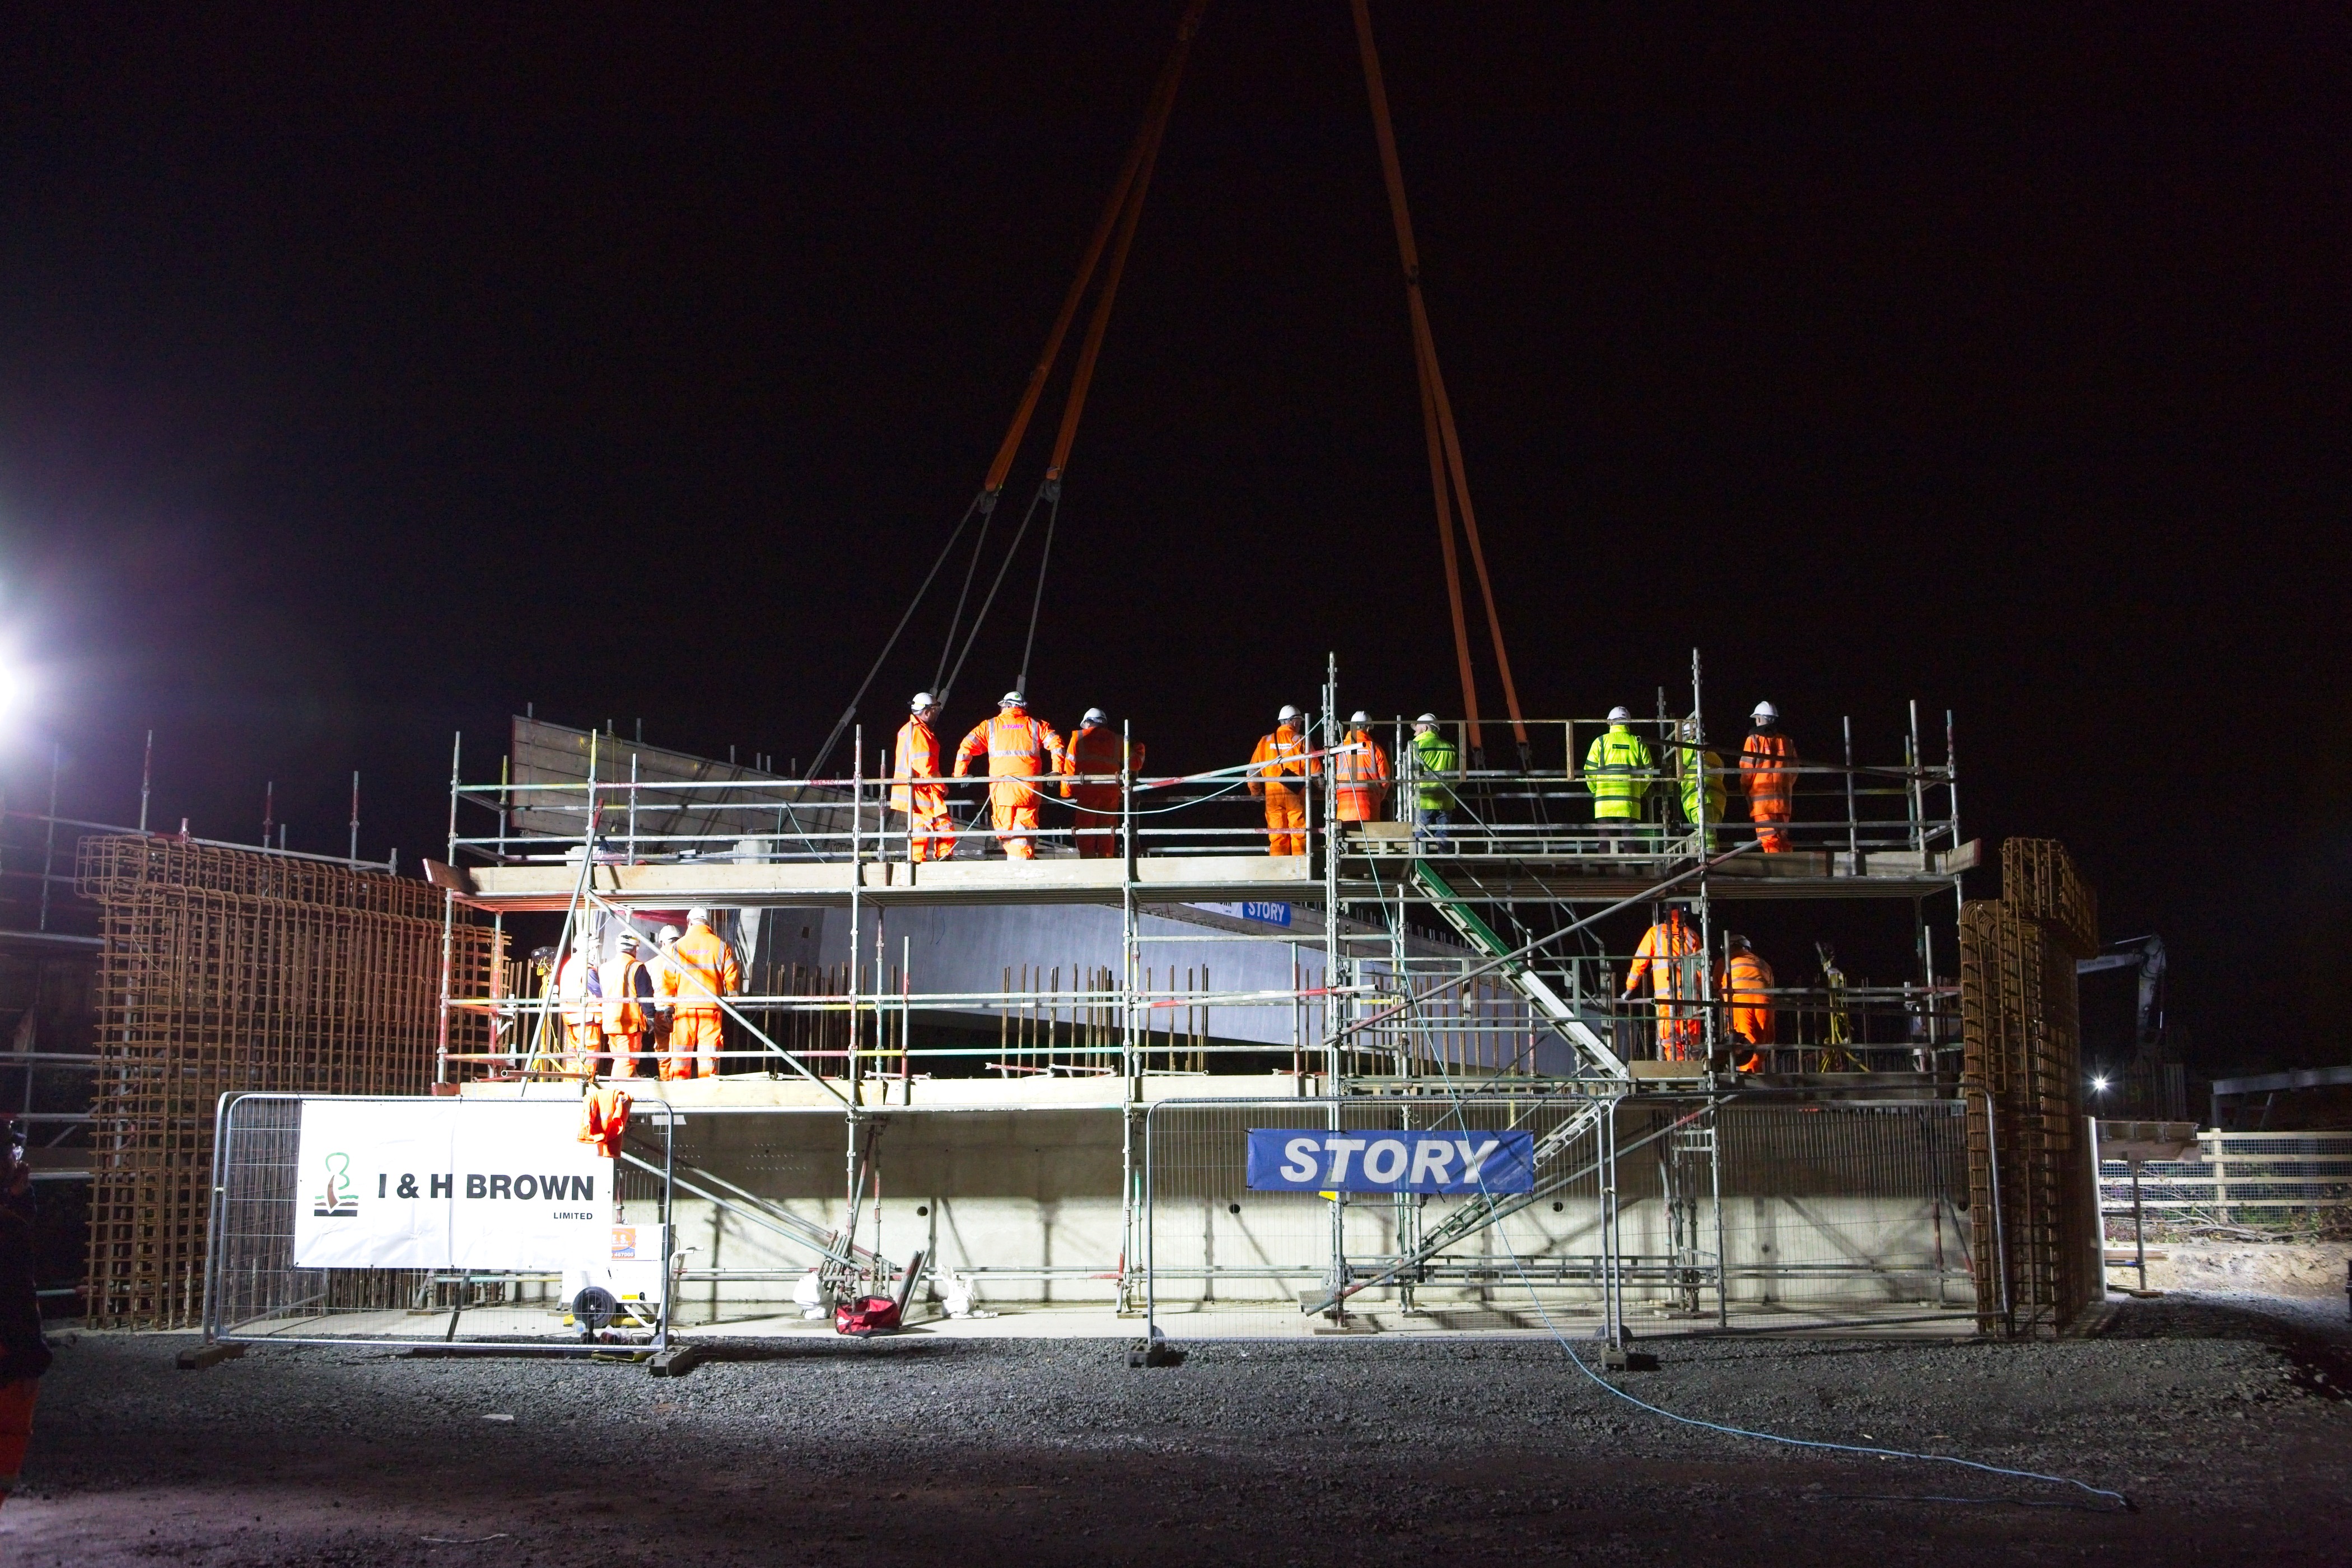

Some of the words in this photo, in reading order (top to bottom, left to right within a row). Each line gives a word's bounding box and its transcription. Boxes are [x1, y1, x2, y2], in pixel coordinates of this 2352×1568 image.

[1248, 902, 1285, 922] STORY
[1280, 1138, 1499, 1184] STORY
[378, 1173, 387, 1198] I
[396, 1173, 421, 1199] &
[430, 1173, 453, 1198] H
[466, 1174, 594, 1201] BROWN
[553, 1212, 593, 1220] LIMITED
